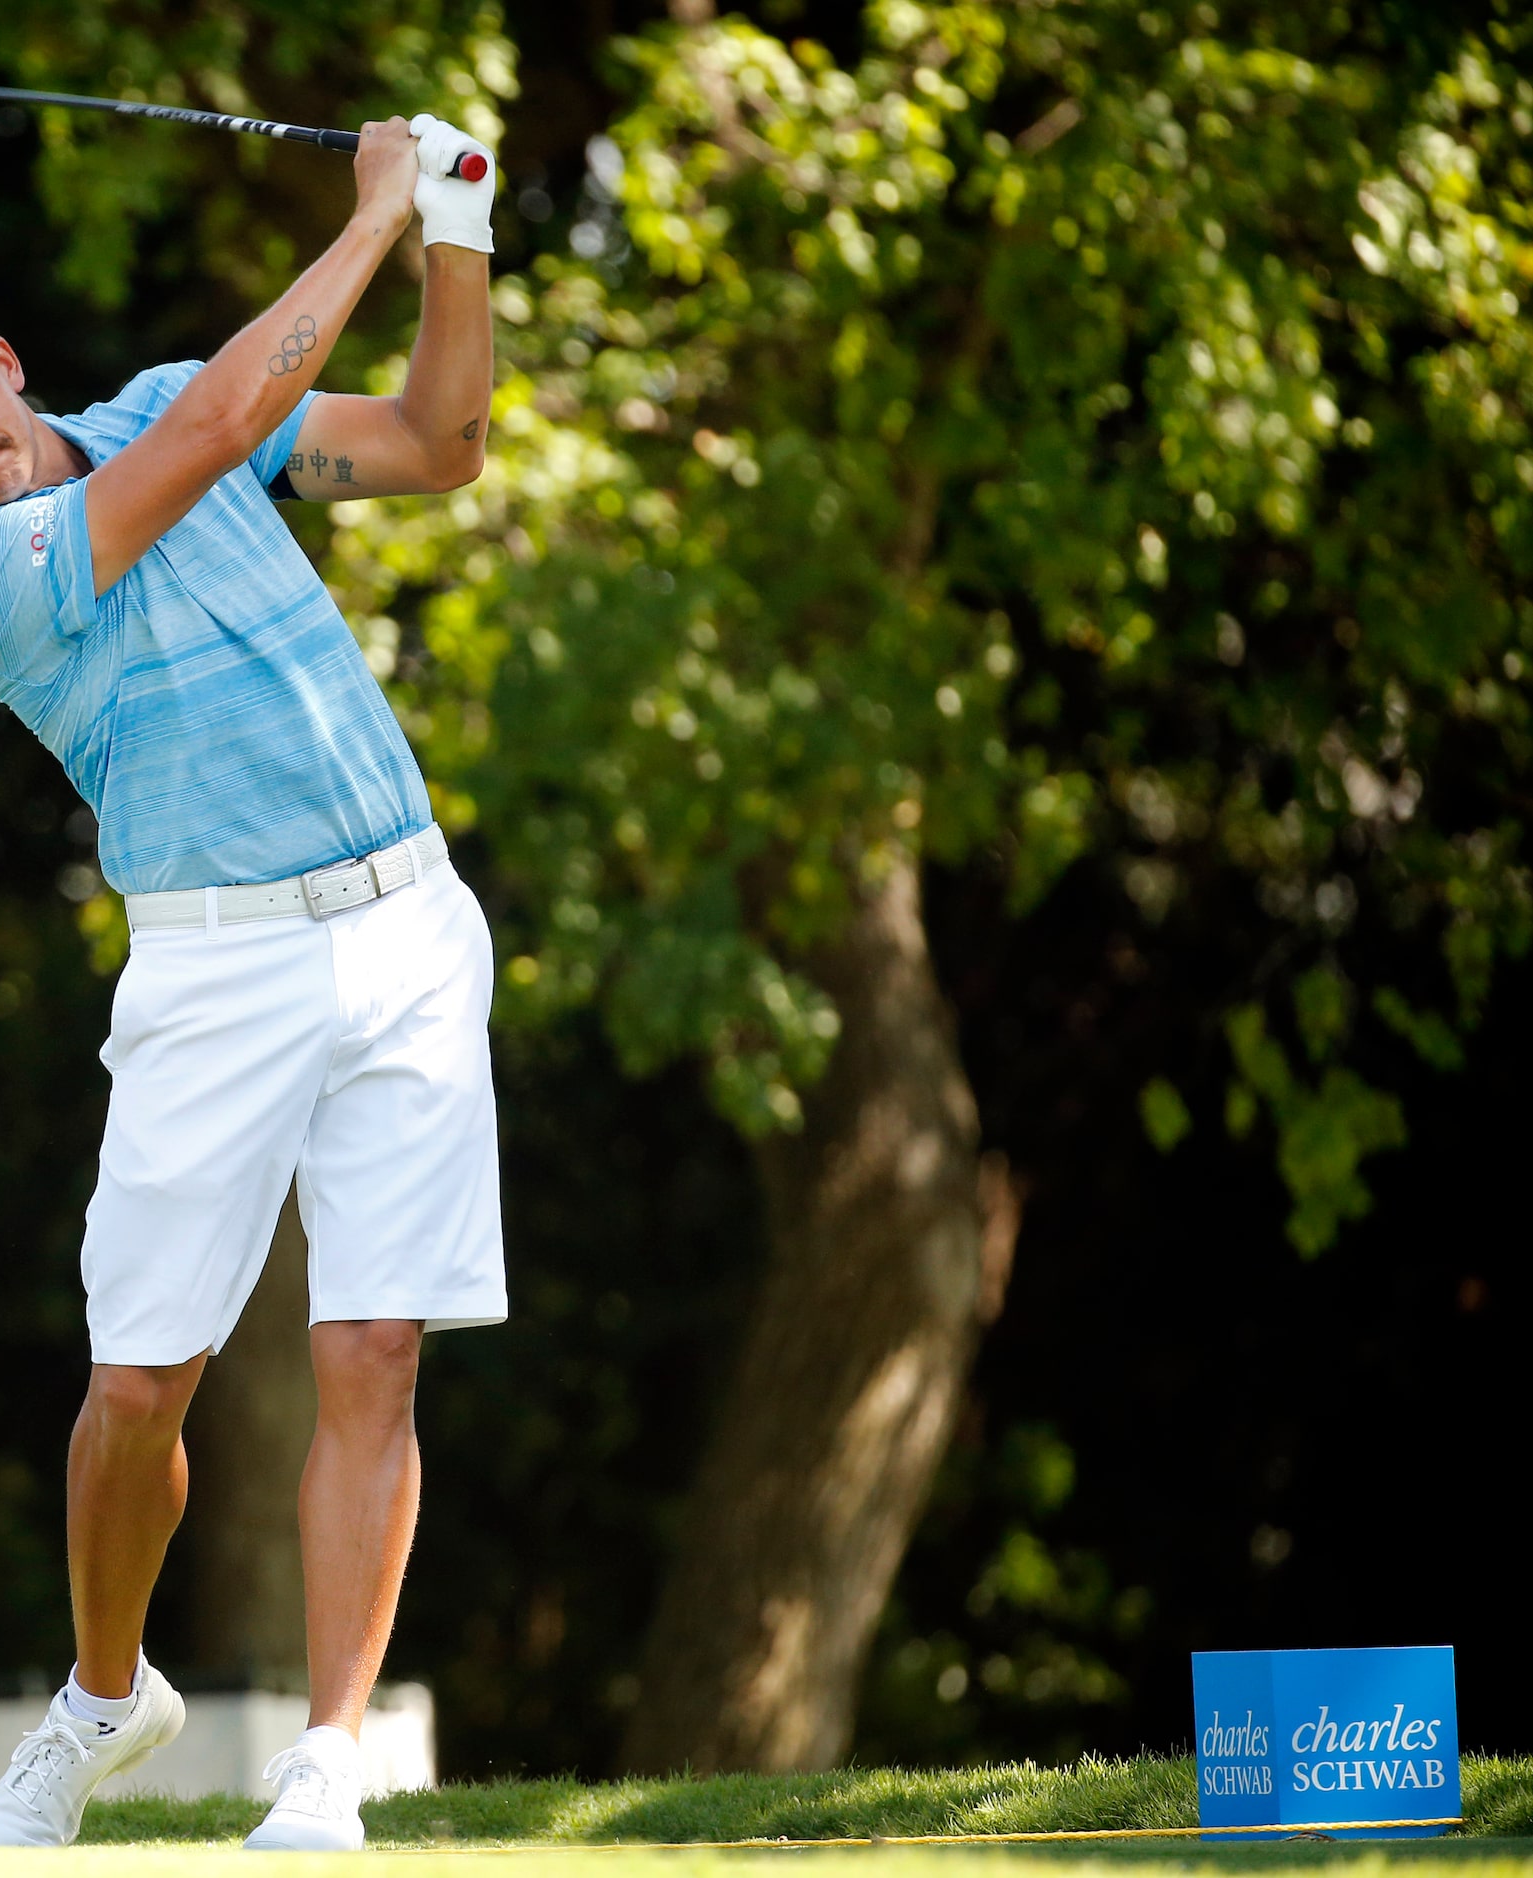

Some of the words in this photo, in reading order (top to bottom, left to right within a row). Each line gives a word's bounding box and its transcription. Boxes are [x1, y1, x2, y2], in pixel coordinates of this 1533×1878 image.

[1202, 1710, 1269, 1758] charles
[1291, 1703, 1442, 1753] charles
[1204, 1766, 1273, 1796] SCHWAB
[1293, 1759, 1445, 1792] SCHWAB
